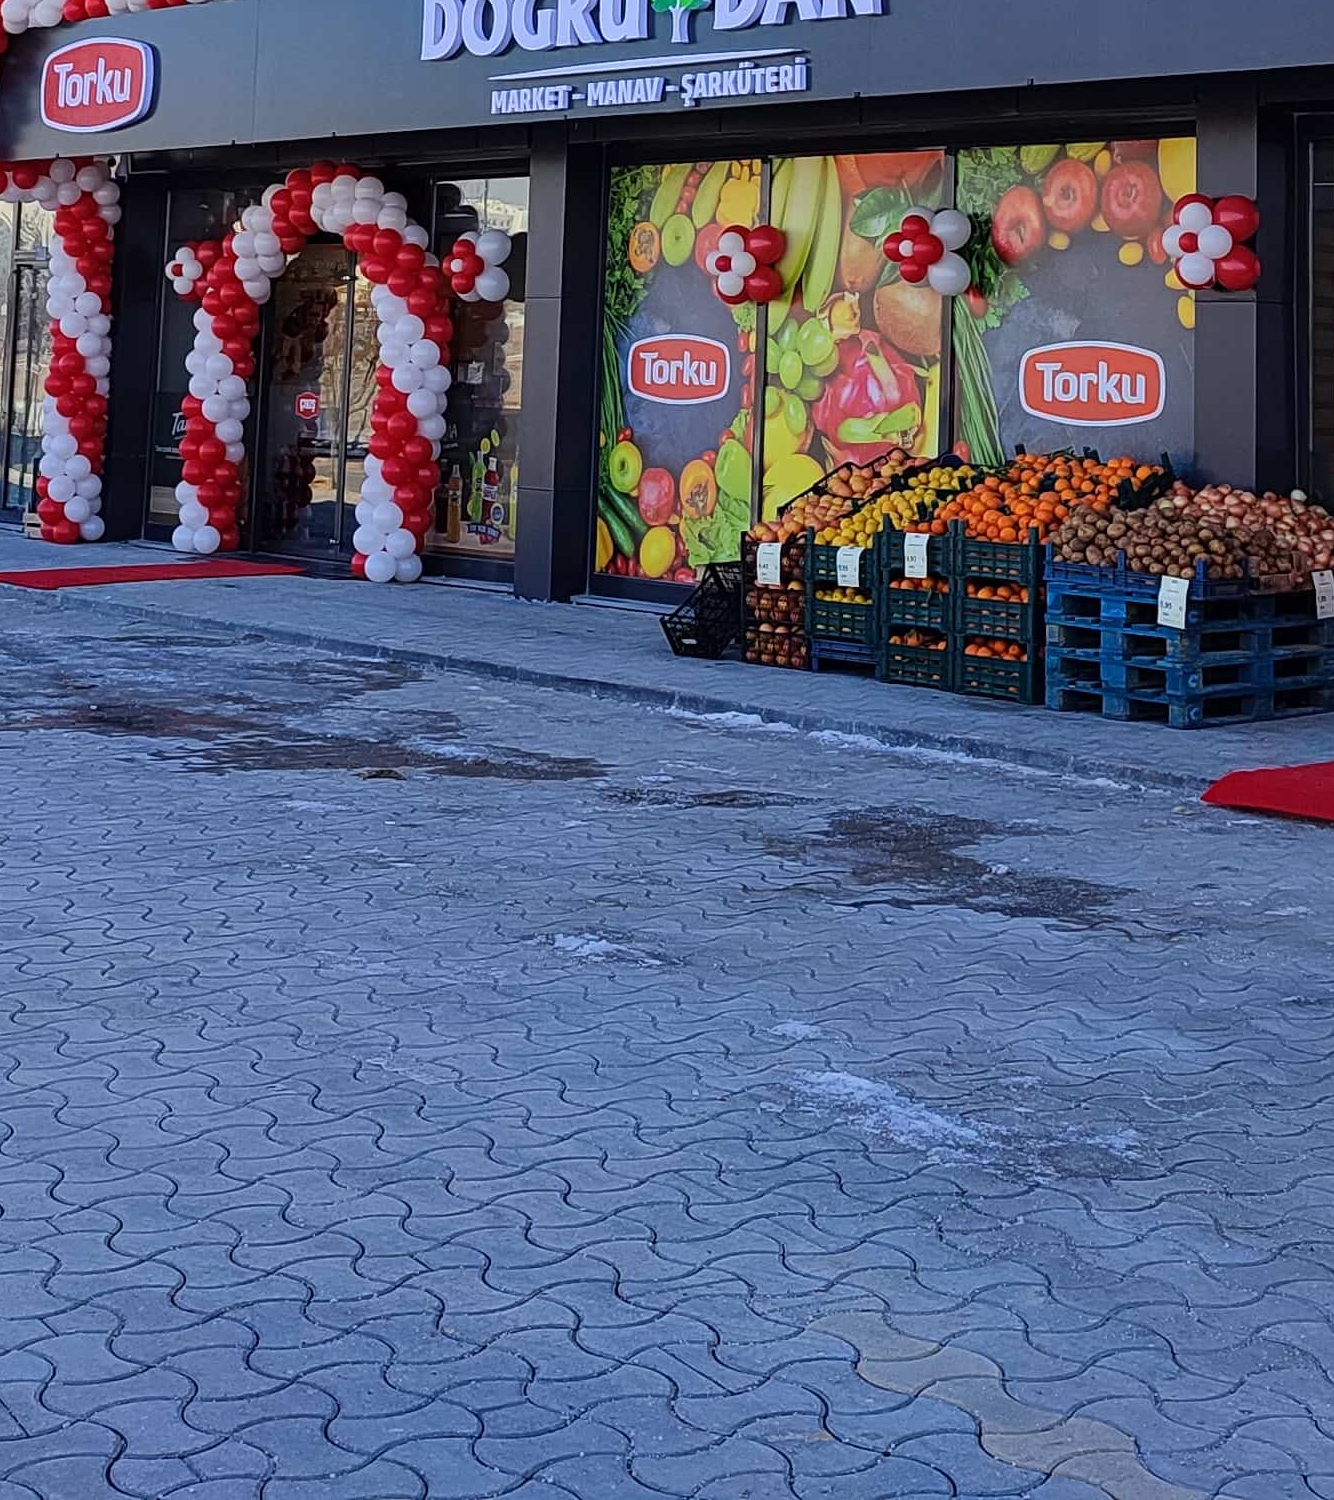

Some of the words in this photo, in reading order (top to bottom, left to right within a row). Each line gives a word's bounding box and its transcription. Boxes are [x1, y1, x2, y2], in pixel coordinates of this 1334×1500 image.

[53, 57, 132, 108] Torku
[490, 84, 572, 115] MARKET
[586, 76, 665, 107] MANAV
[680, 56, 807, 107] ŞARKÜTERİ
[638, 350, 717, 386] Torku
[1034, 360, 1146, 404] Torku
